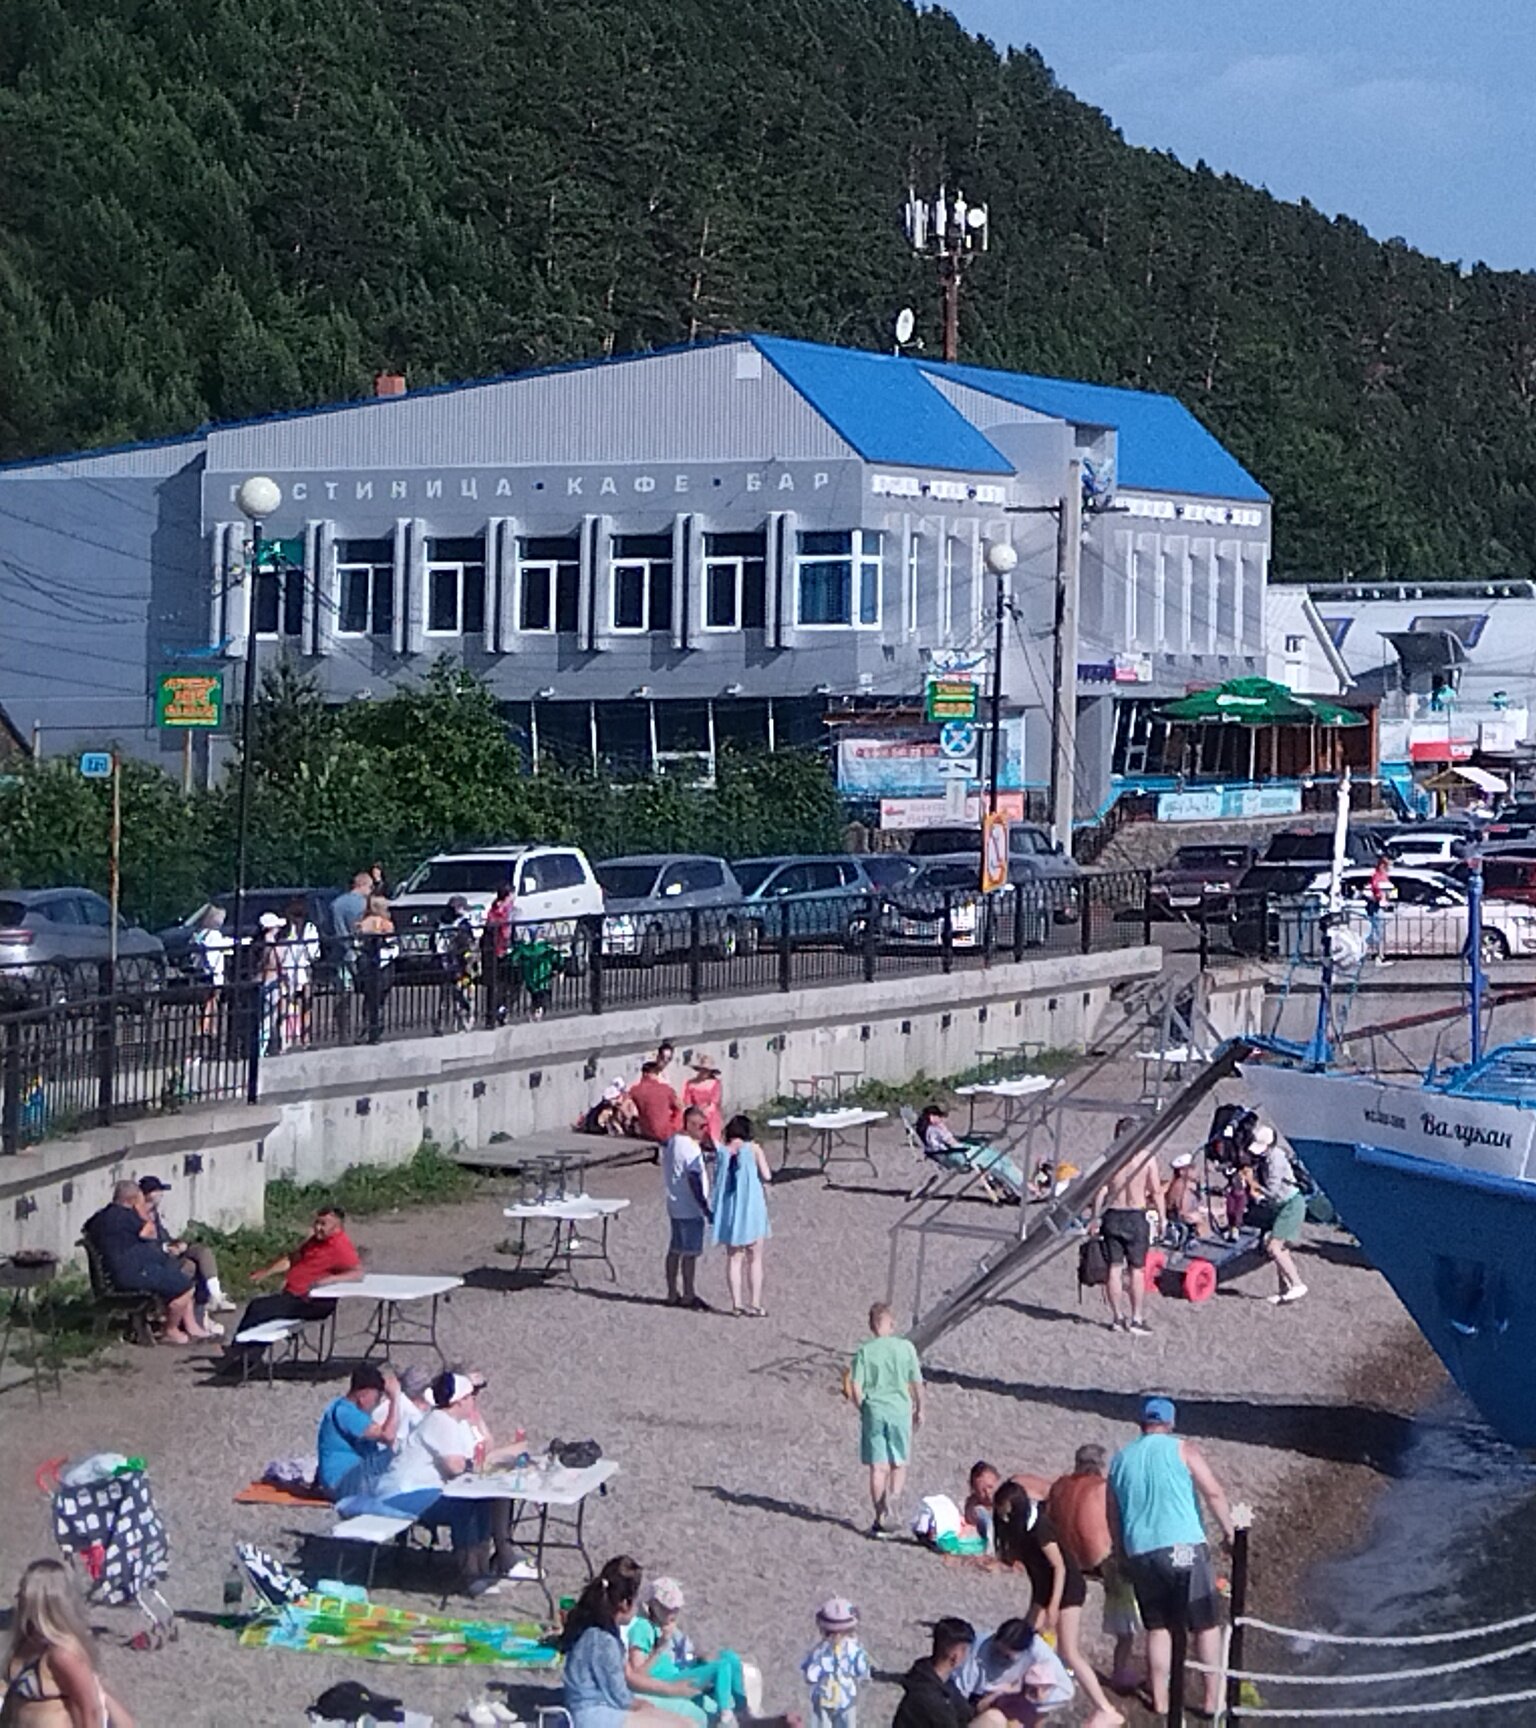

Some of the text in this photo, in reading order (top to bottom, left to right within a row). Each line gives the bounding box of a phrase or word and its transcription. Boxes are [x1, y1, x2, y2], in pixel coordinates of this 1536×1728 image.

[229, 472, 830, 502] ГСТИНИЦА КАФЕ БАР
